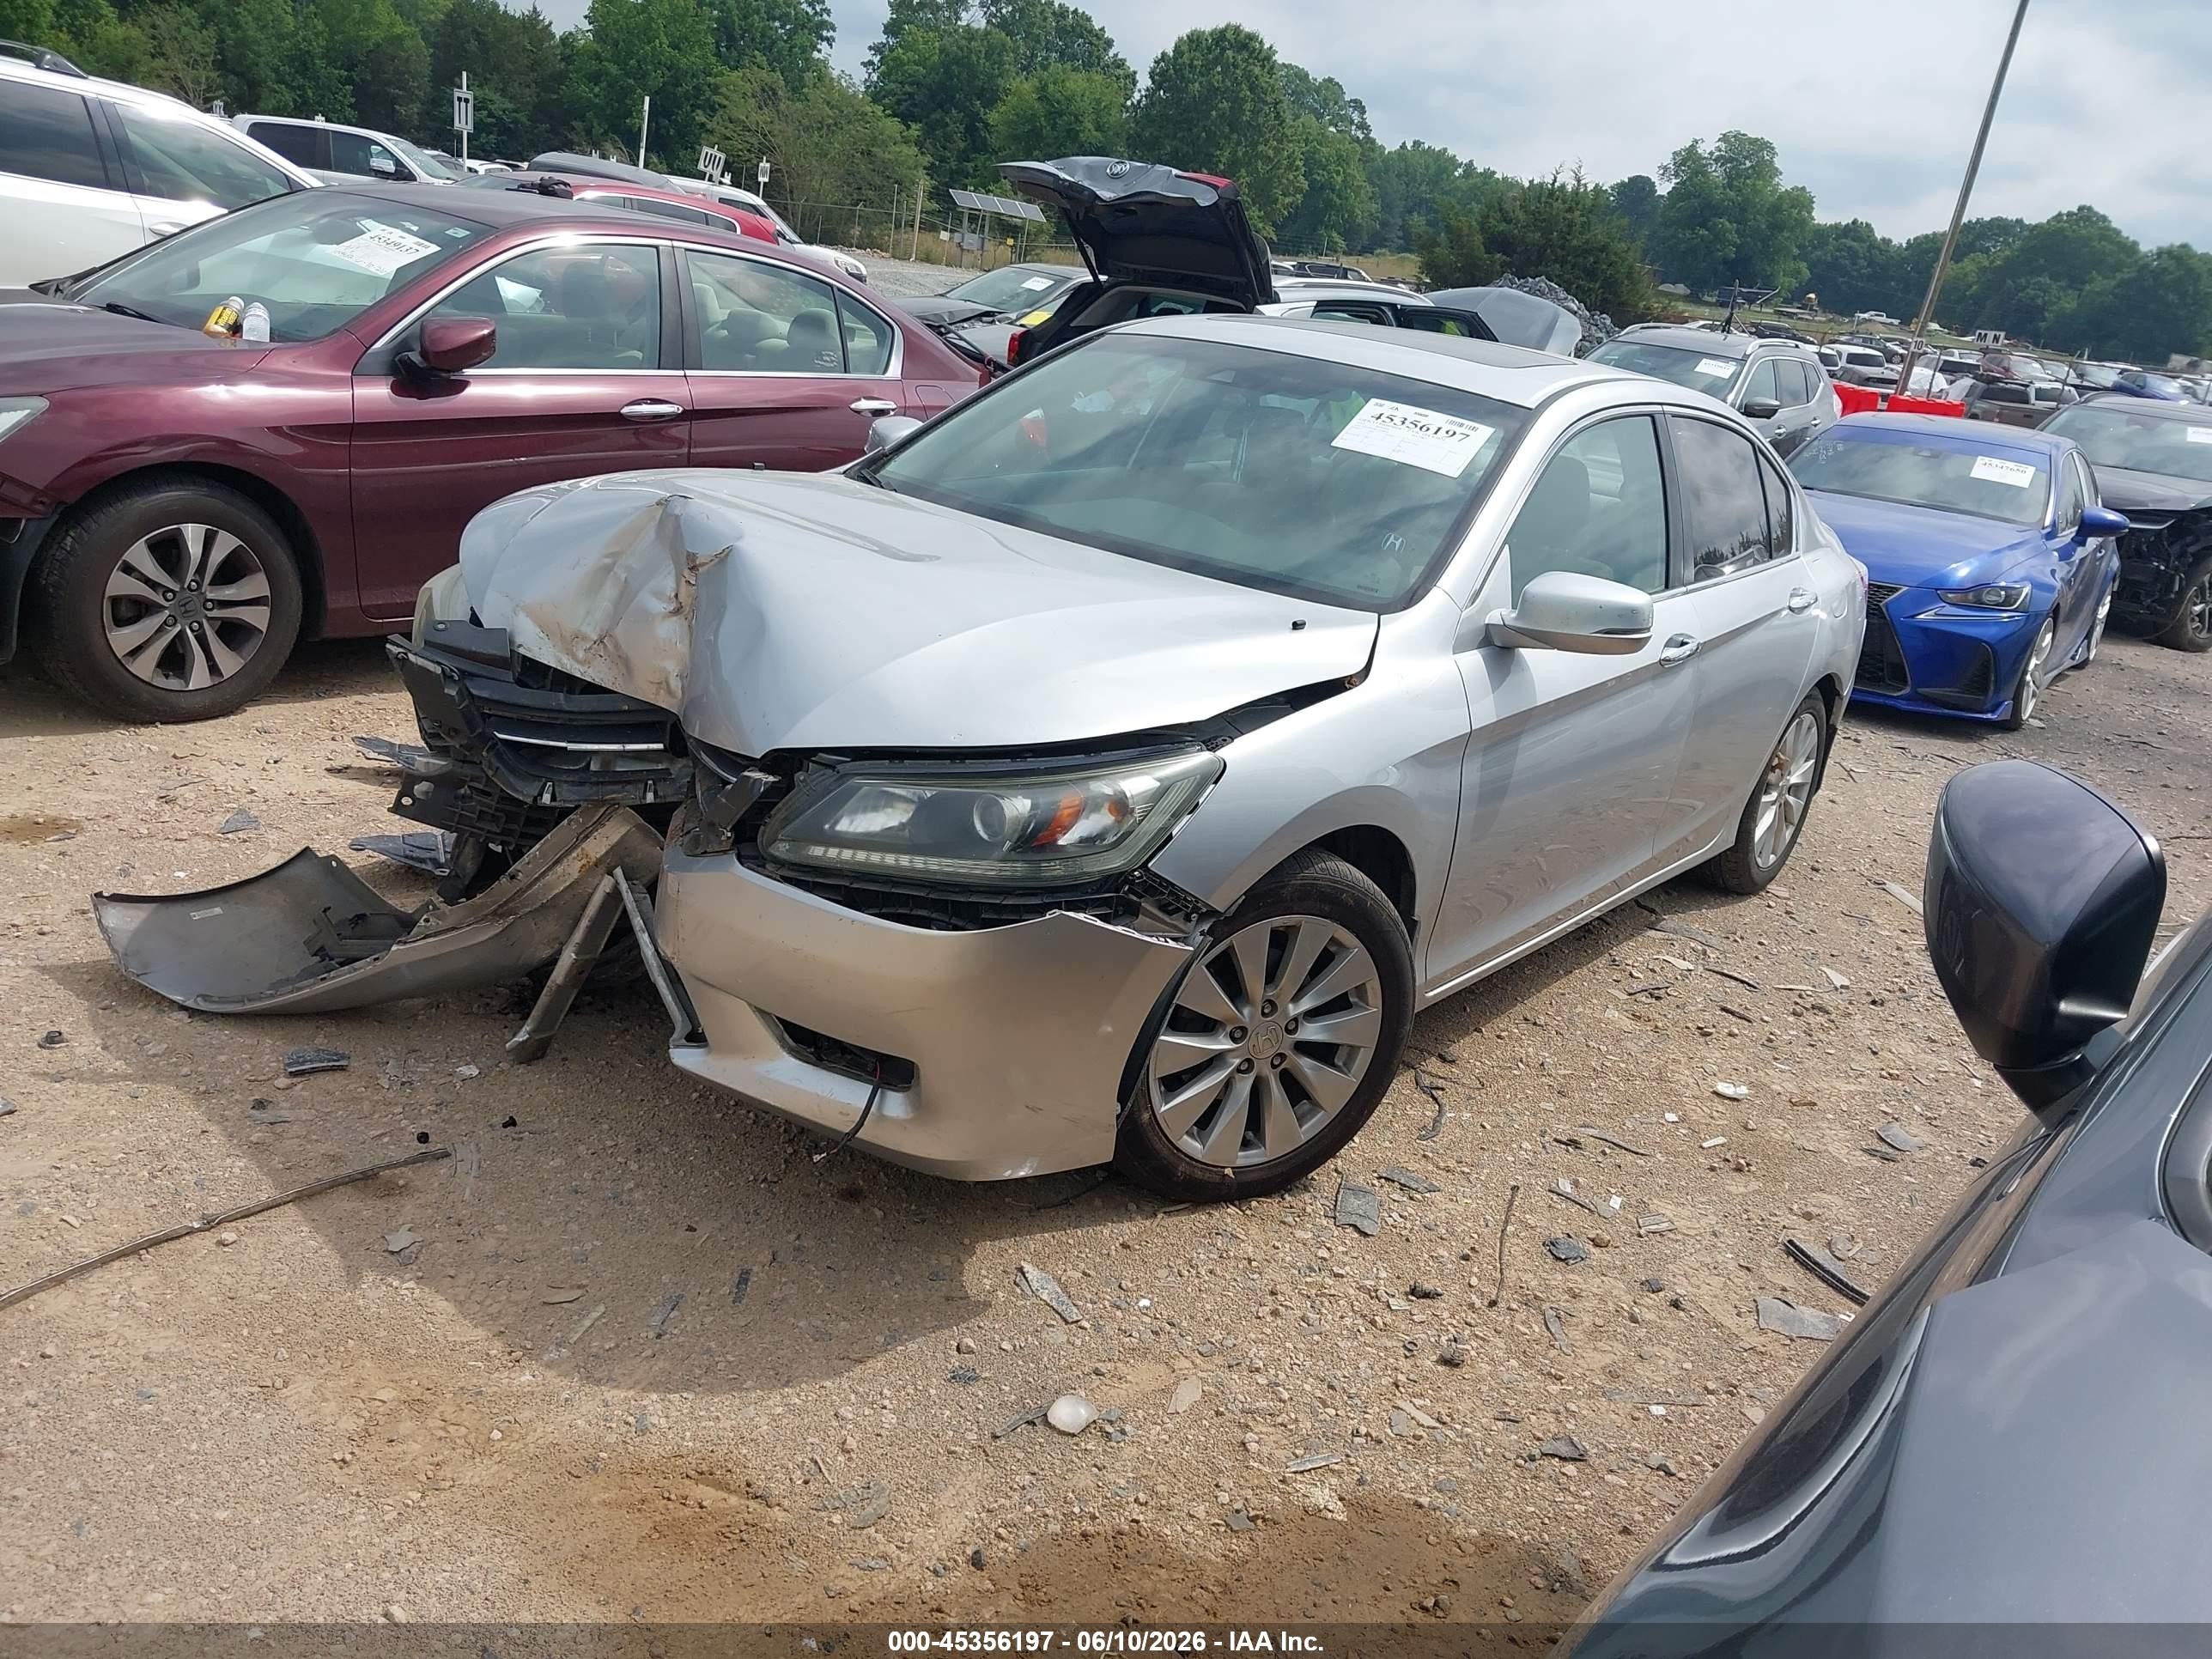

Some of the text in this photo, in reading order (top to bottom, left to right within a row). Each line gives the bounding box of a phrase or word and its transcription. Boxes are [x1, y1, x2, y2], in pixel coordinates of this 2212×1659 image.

[457, 96, 470, 125] TT
[704, 150, 722, 171] UU
[1913, 339, 1923, 351] 10
[1976, 331, 2002, 344] M N
[1370, 412, 1471, 443] 45356197
